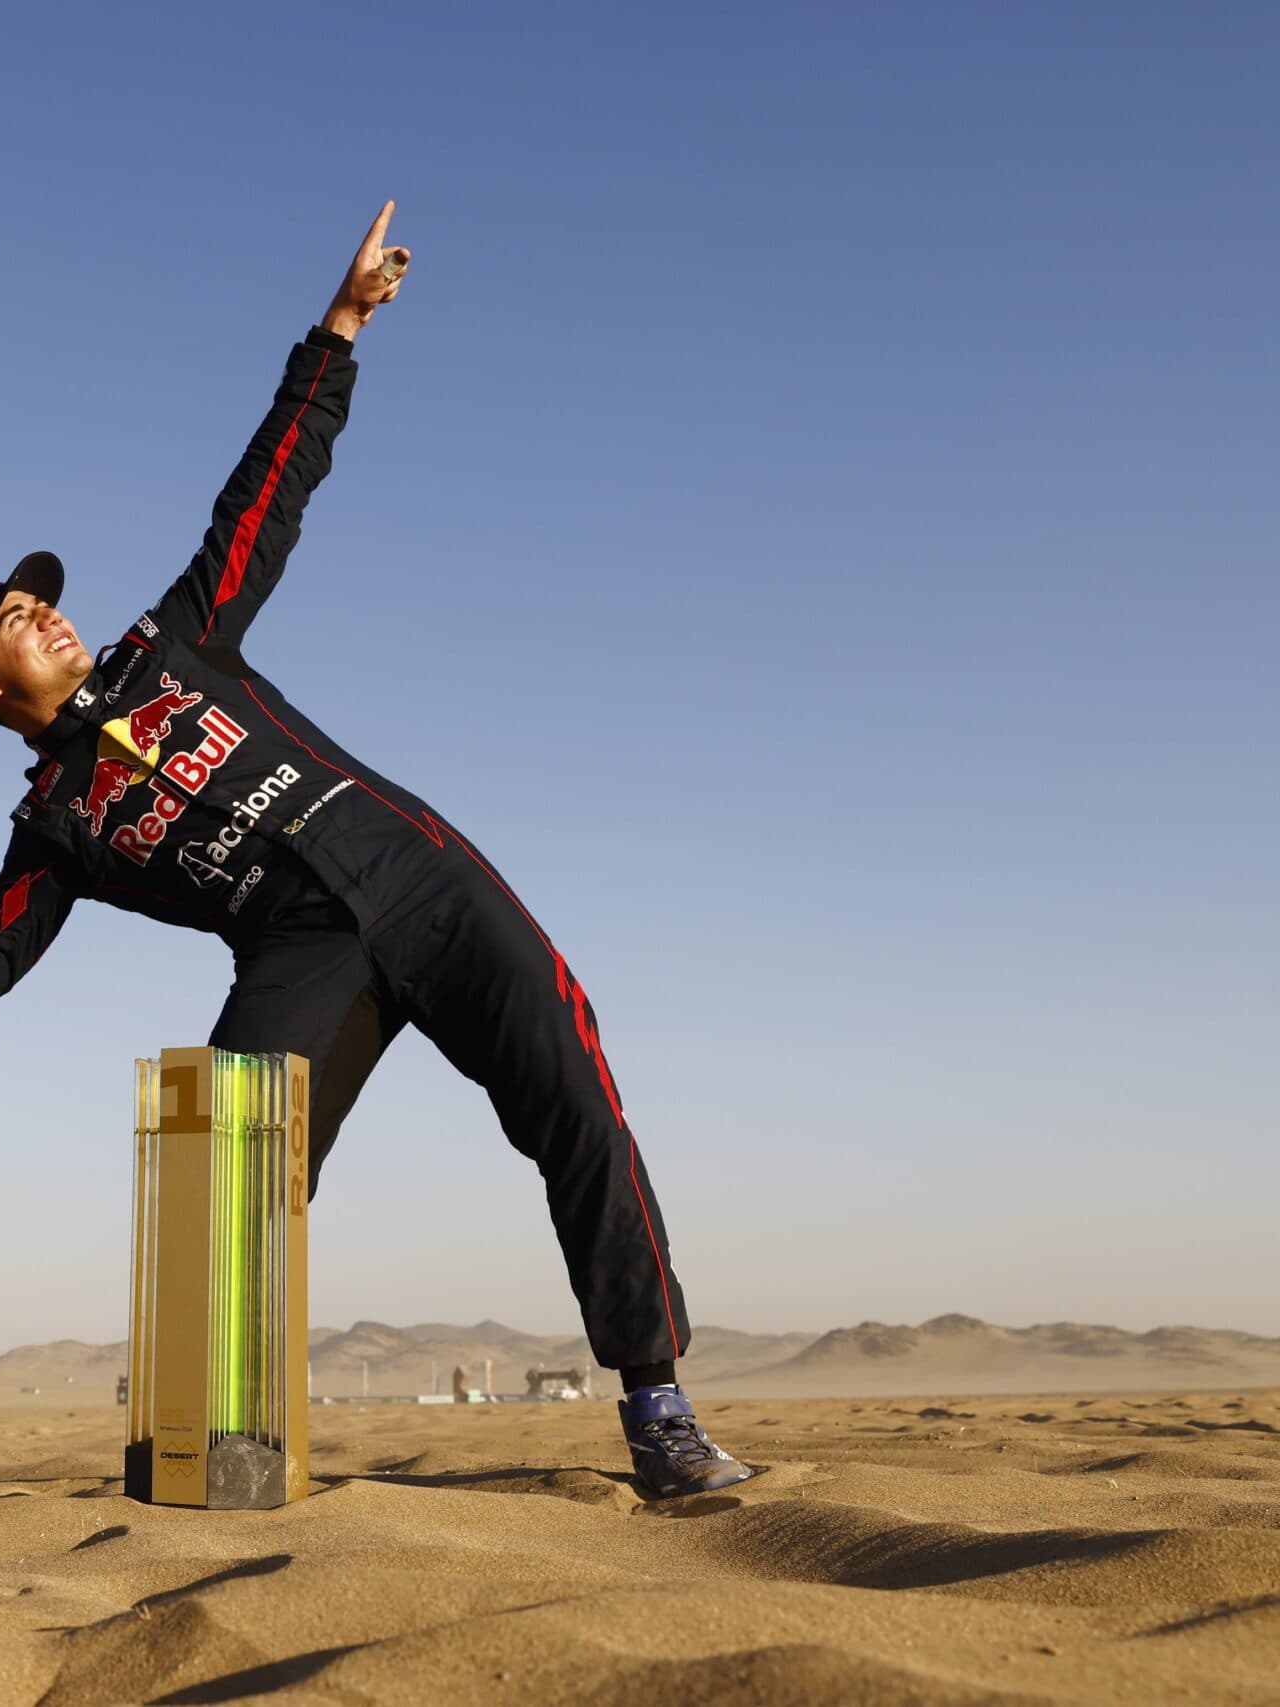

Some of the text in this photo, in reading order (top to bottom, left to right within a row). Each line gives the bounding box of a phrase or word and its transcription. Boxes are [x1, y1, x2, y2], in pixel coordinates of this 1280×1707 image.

[109, 705, 249, 868] Red Bull
[206, 763, 302, 863] acciona
[228, 865, 265, 916] sparco
[160, 1064, 212, 1135] 1
[290, 1073, 305, 1217] R.02
[160, 1452, 199, 1460] DESERT
